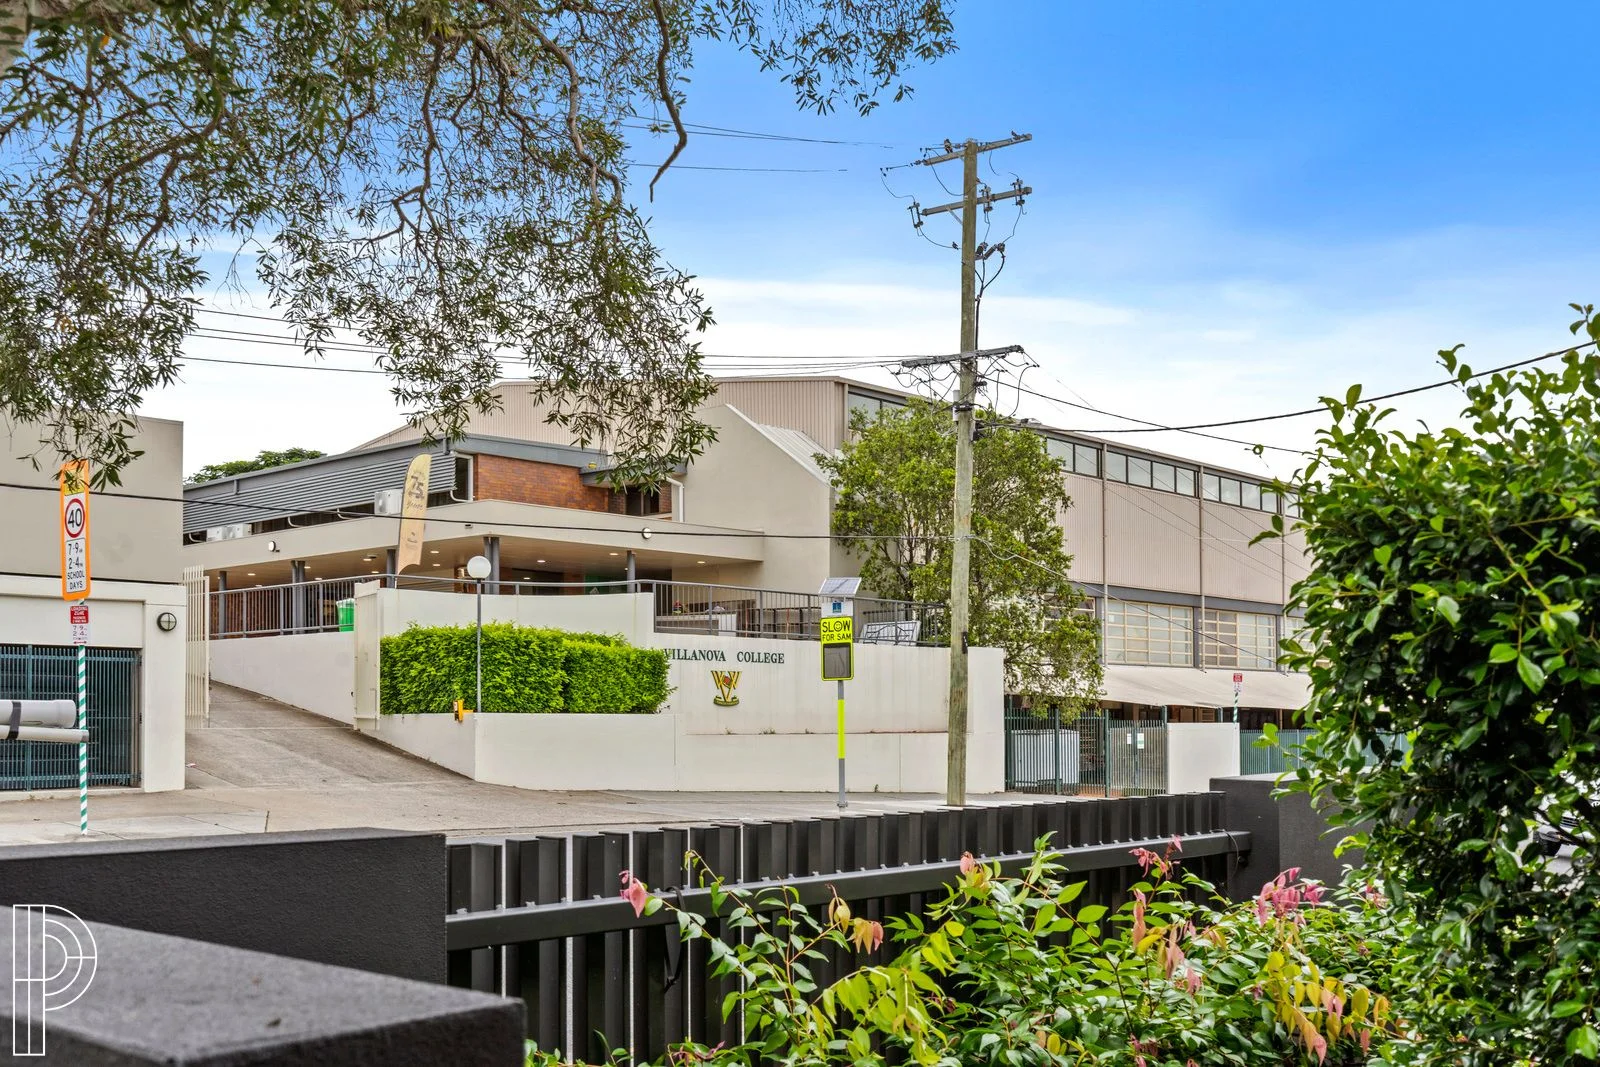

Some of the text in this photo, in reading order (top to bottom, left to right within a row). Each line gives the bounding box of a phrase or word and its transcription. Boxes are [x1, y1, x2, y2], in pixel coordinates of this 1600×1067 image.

[68, 508, 82, 528] 40
[67, 570, 85, 580] SCHOOL
[70, 581, 83, 590] DAYS
[822, 620, 851, 633] SLOW
[664, 648, 785, 664] VILLANOVA COLLEGE
